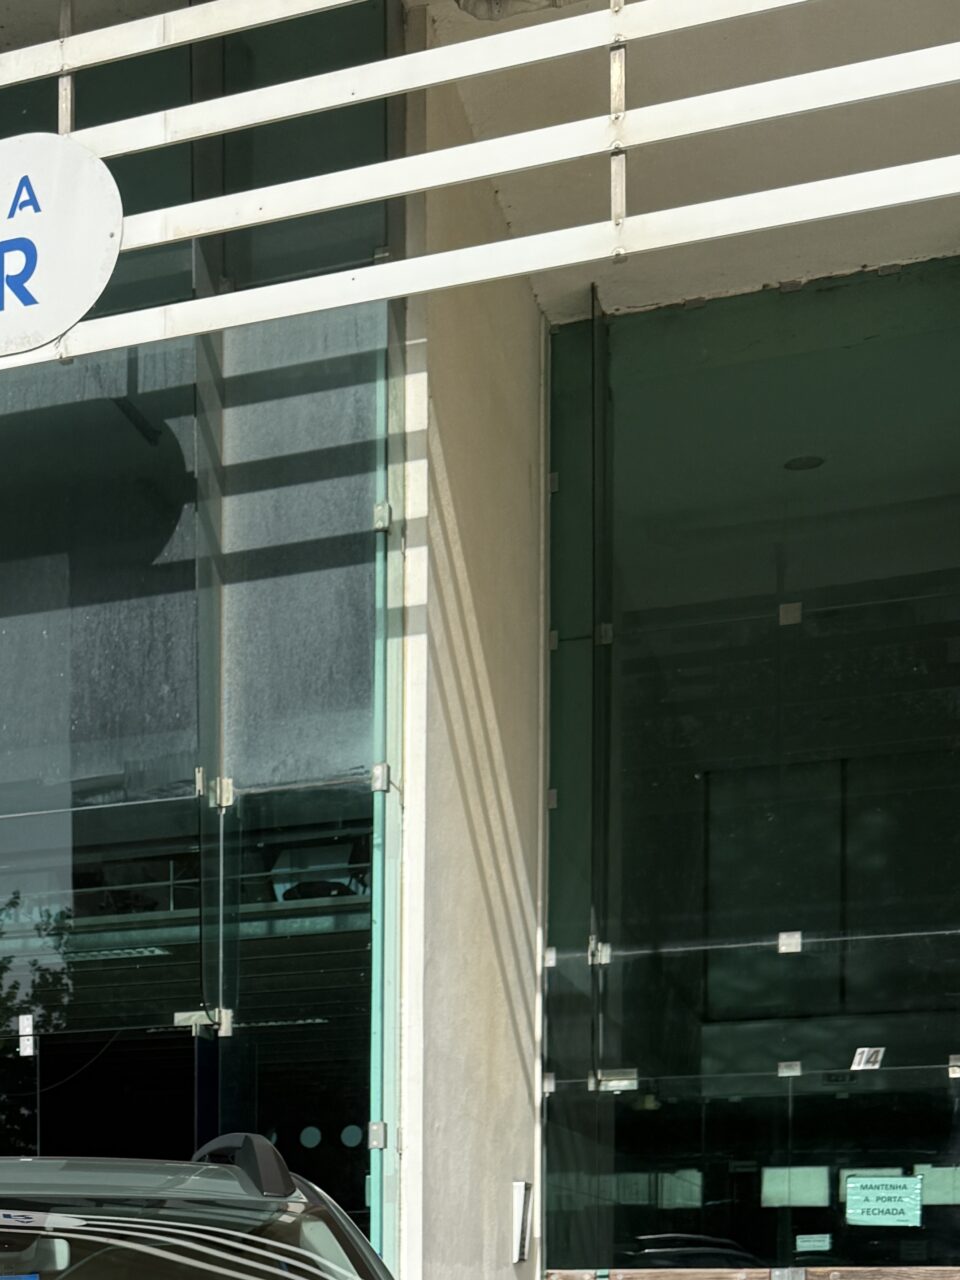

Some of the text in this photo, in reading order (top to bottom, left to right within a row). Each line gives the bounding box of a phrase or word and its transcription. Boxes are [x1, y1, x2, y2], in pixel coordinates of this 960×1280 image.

[854, 1049, 880, 1067] 14
[859, 1183, 908, 1191] MANTENHA
[875, 1195, 904, 1203] PORTA
[860, 1207, 905, 1216] FECHADA
